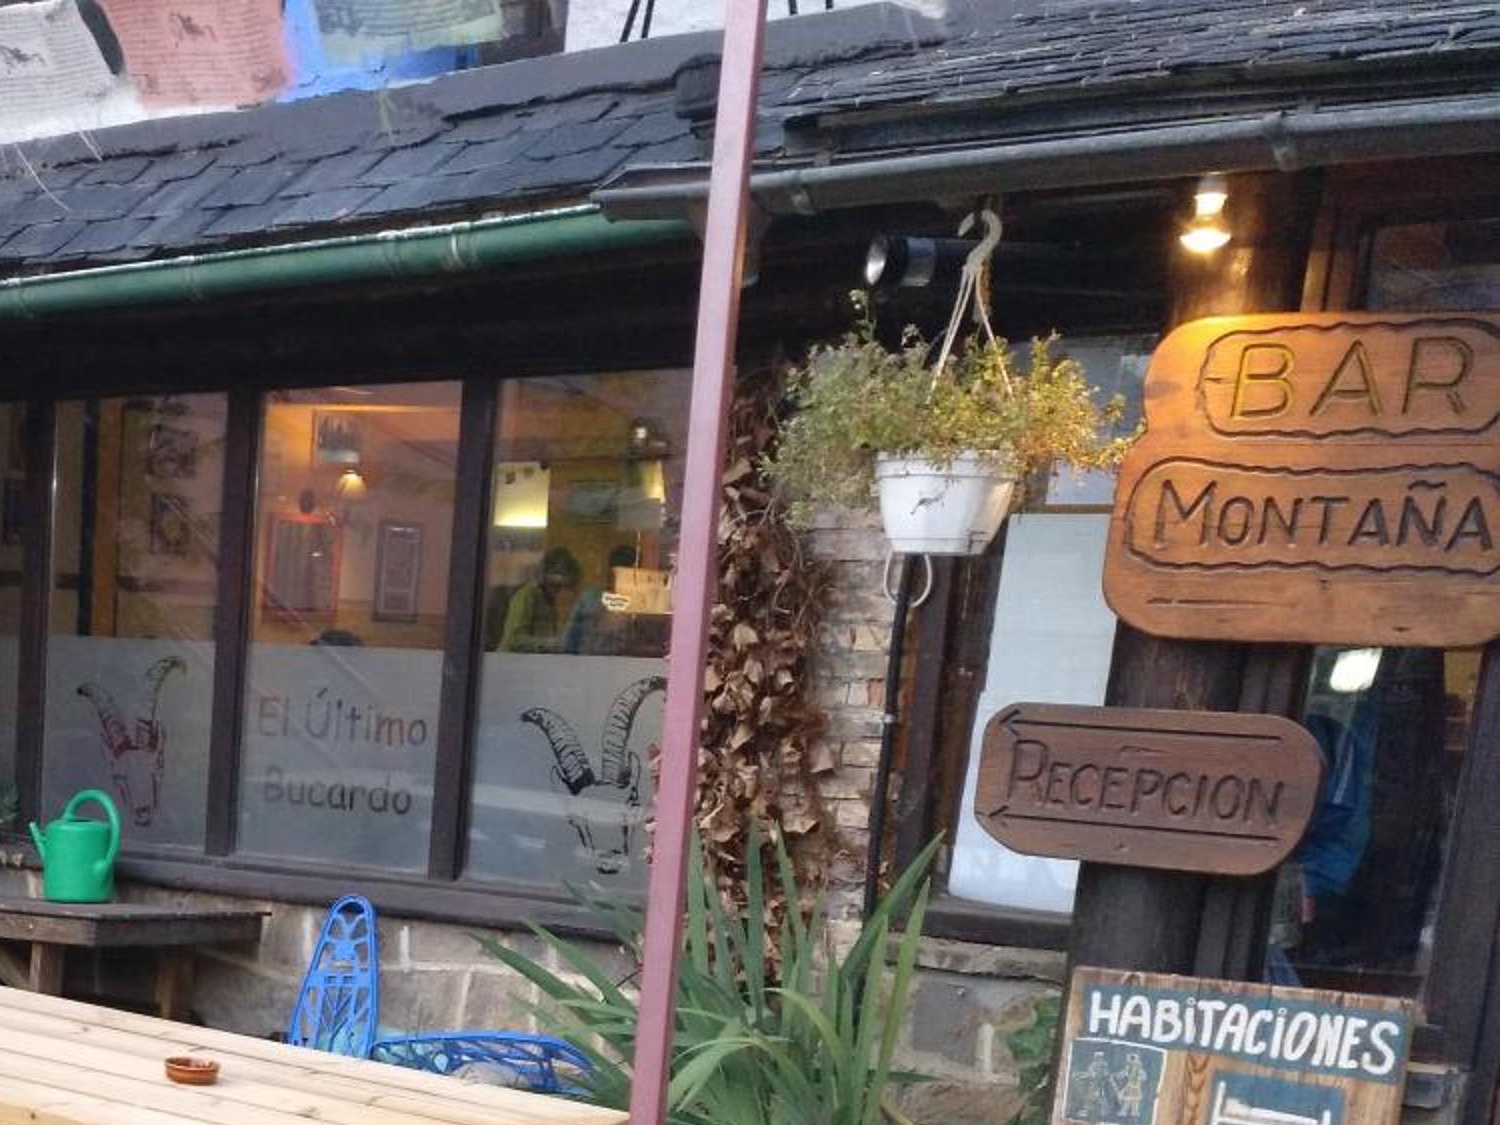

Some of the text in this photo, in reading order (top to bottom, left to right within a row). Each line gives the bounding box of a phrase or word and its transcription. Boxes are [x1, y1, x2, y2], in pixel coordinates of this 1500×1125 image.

[1229, 335, 1474, 420] BAR
[1154, 479, 1493, 551] MONTAÑA
[260, 694, 290, 737] El
[263, 764, 412, 816] Bucardo
[1007, 739, 1285, 824] RECEPCION
